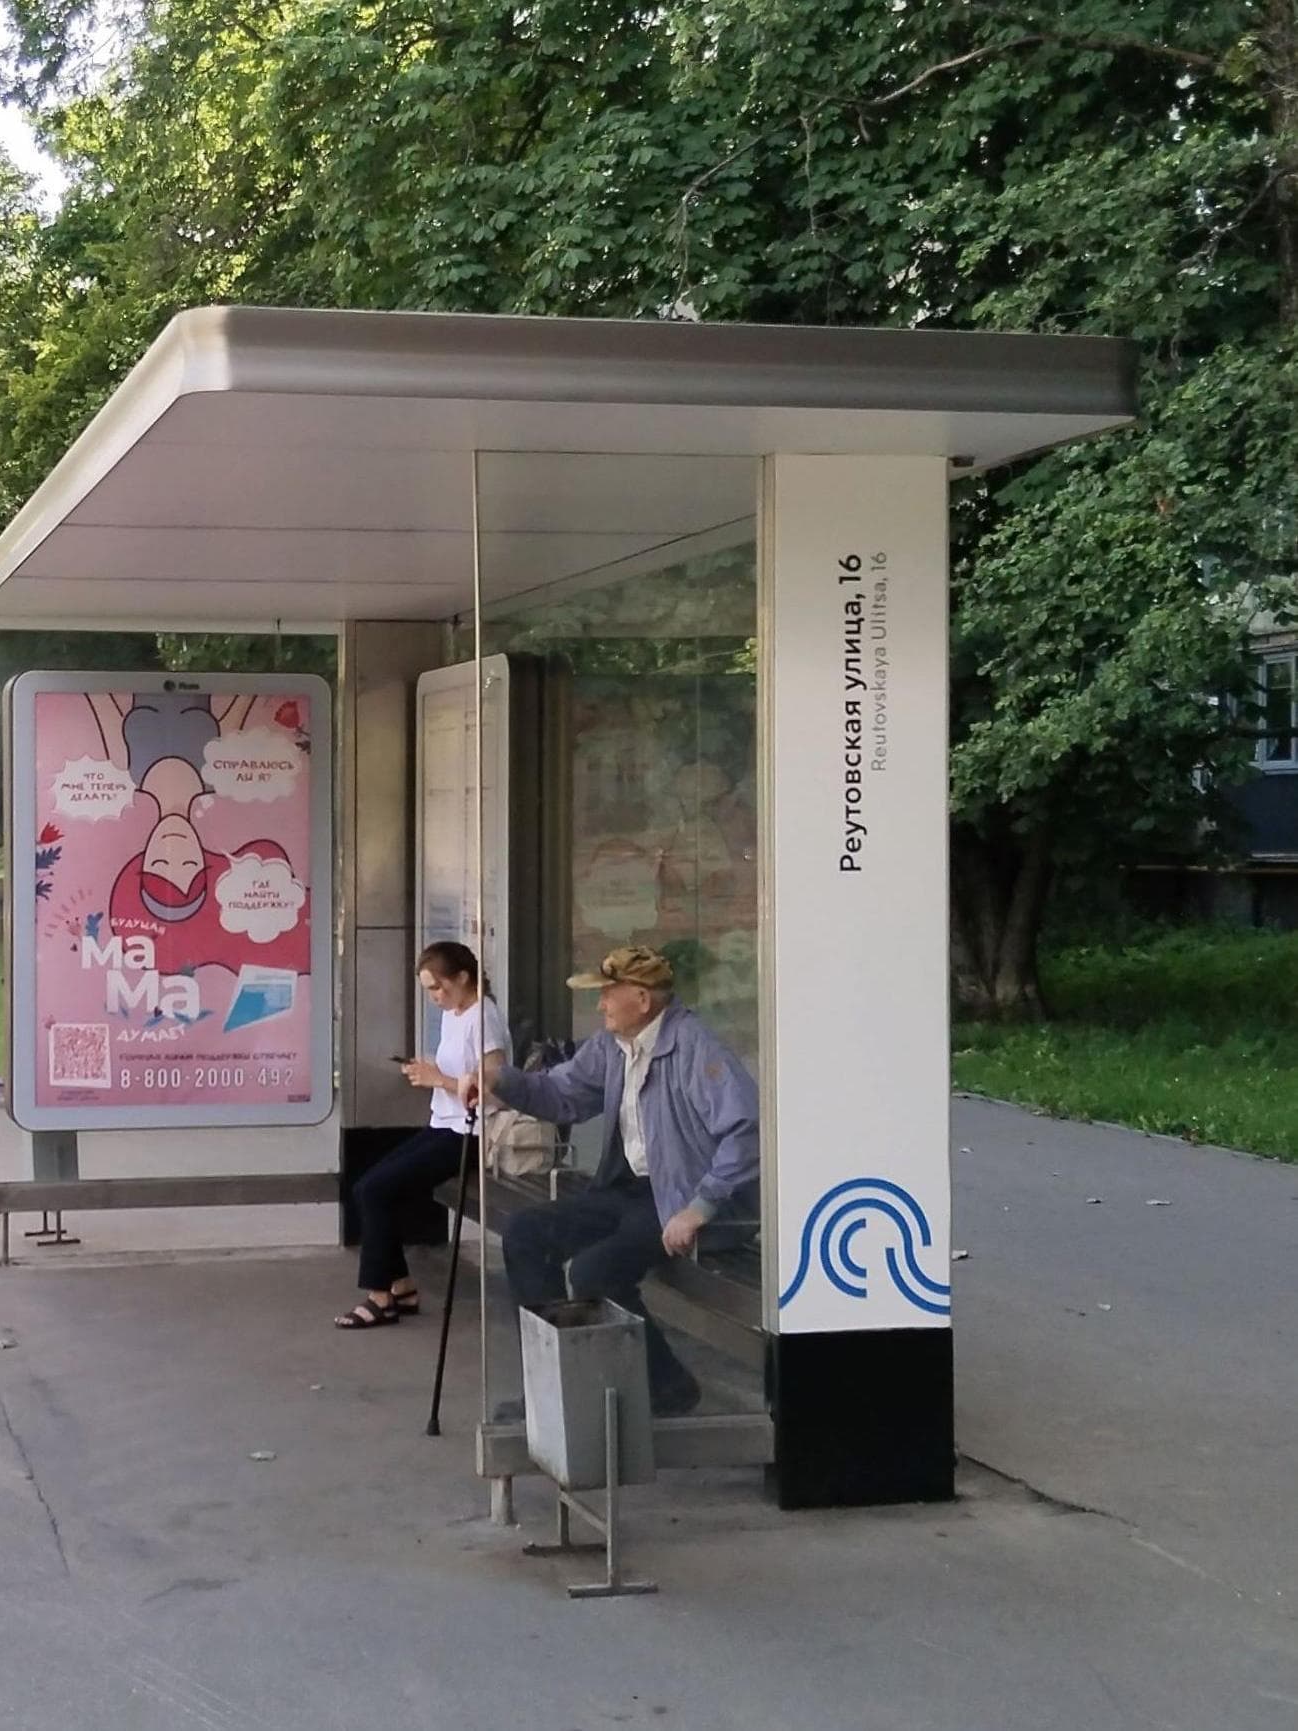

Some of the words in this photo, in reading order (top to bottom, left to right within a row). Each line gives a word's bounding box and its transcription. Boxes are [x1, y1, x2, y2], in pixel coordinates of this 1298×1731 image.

[838, 554, 862, 585] 16
[870, 552, 888, 572] 16
[844, 593, 868, 691] улица,
[869, 577, 889, 640] Ulitsa,
[870, 646, 890, 772] Reutovskaya
[839, 701, 868, 872] Реутовская
